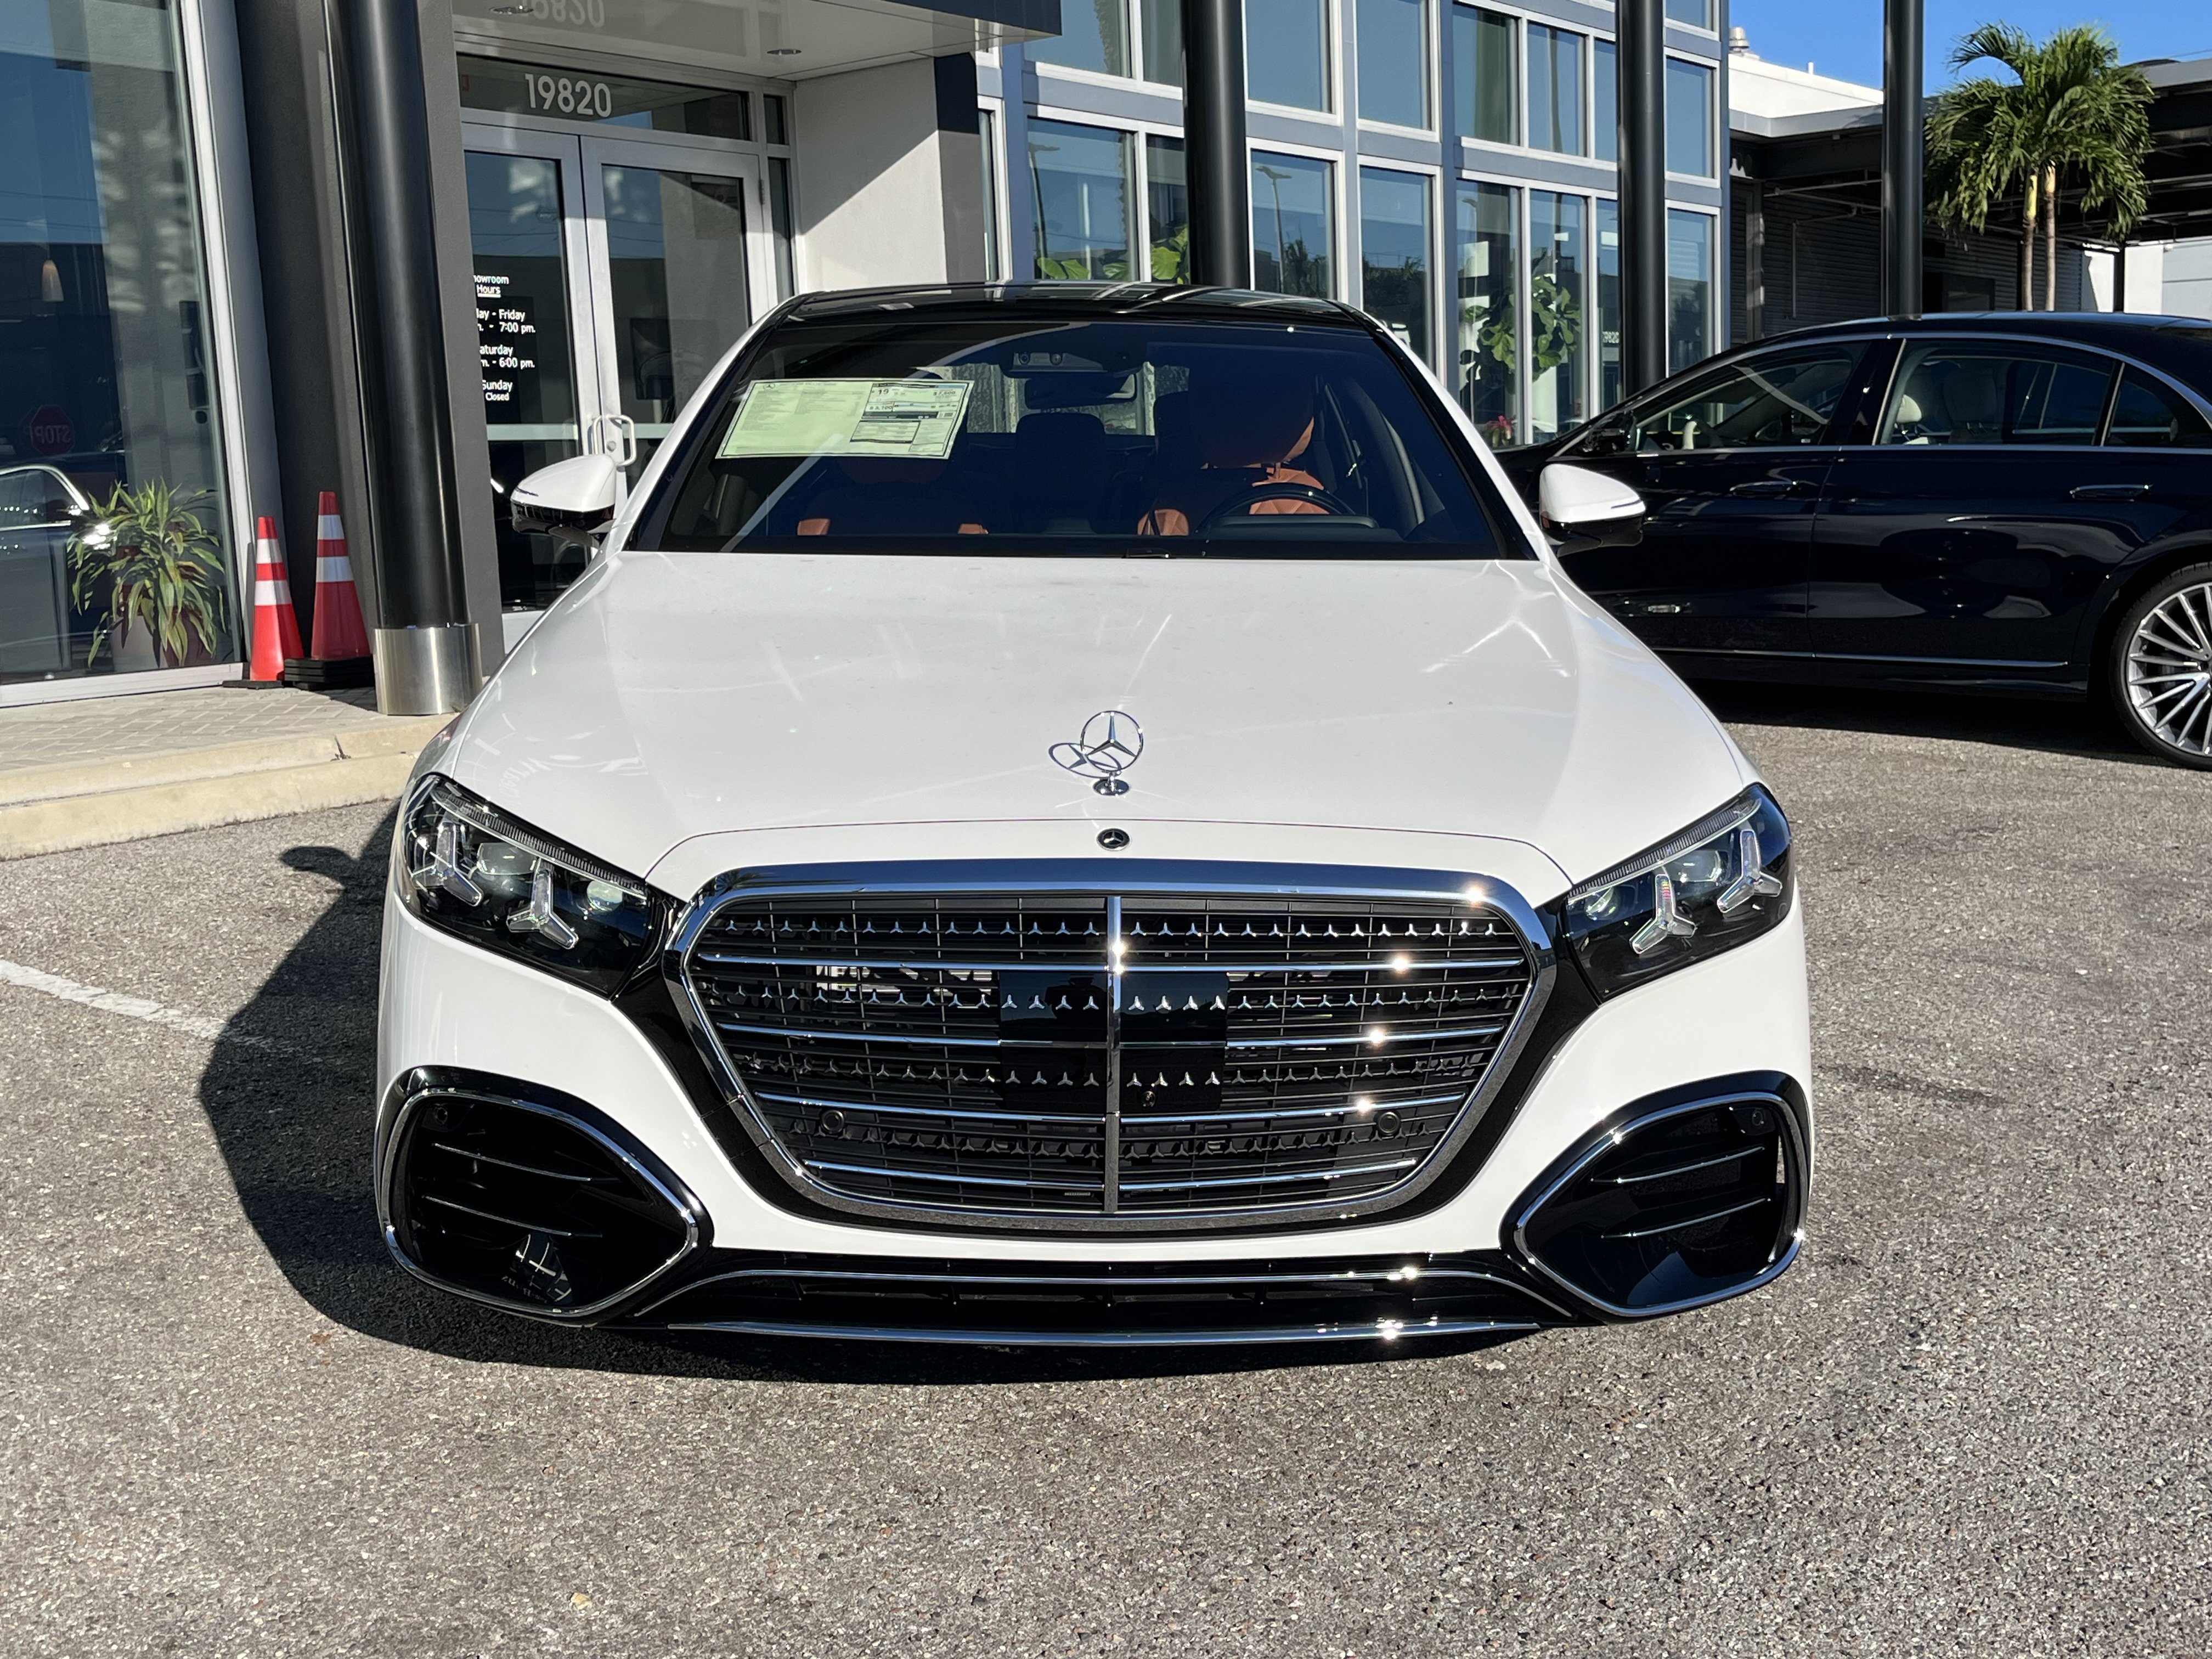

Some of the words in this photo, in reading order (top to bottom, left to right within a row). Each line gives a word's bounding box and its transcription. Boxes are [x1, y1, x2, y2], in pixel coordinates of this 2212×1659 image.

[524, 73, 612, 118] 19820
[473, 275, 509, 285] owroom
[476, 284, 501, 295] Hours
[498, 308, 526, 322] Friday
[499, 321, 518, 333] 7:00
[521, 325, 535, 335] pm.
[479, 345, 514, 357] aturday
[499, 357, 518, 368] 6:00
[520, 360, 535, 370] pm.
[482, 380, 513, 392] Sunday
[486, 392, 510, 401] Closed
